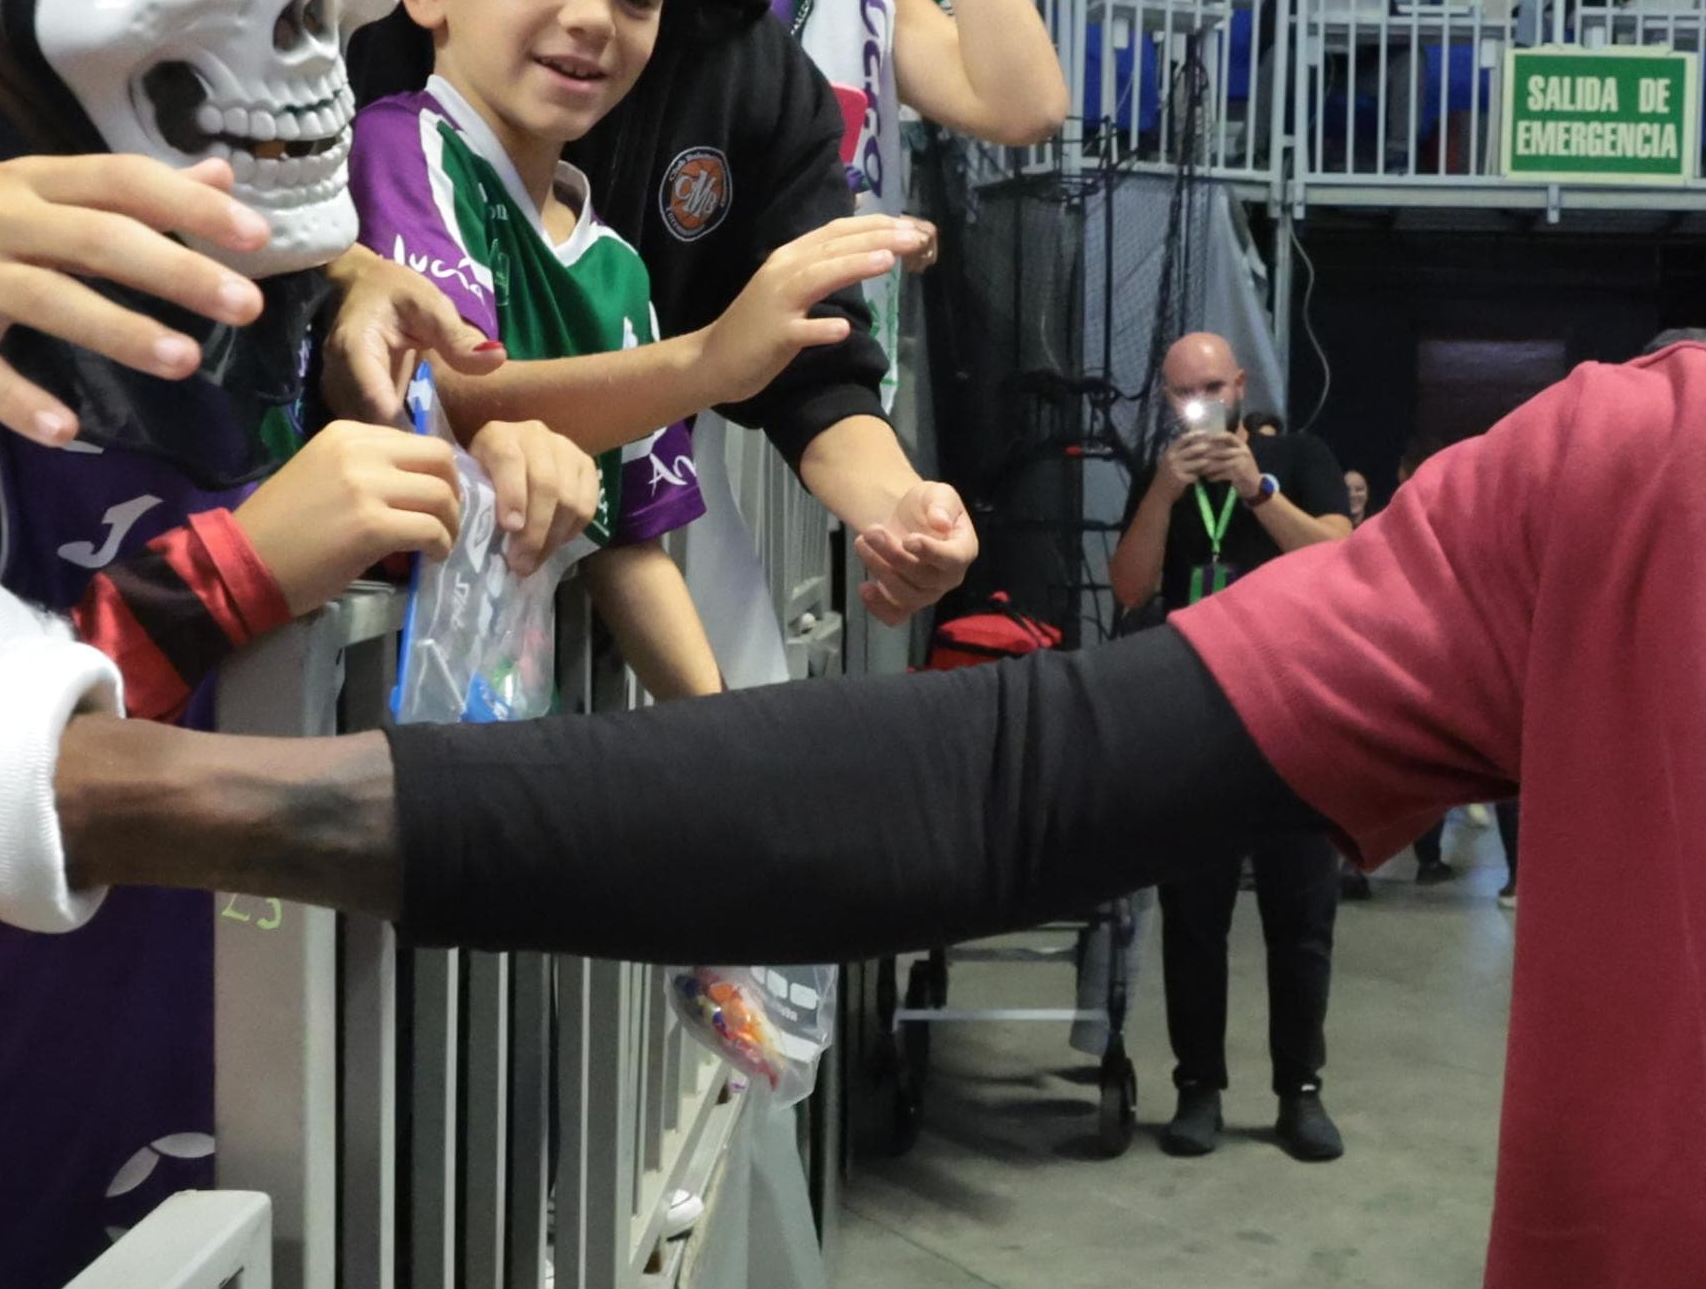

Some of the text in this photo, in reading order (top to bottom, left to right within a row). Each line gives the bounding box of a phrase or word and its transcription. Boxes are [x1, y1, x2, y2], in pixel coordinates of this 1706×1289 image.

[1527, 75, 1671, 113] SALIDA DE
[1516, 121, 1678, 158] EMERGENCIA
